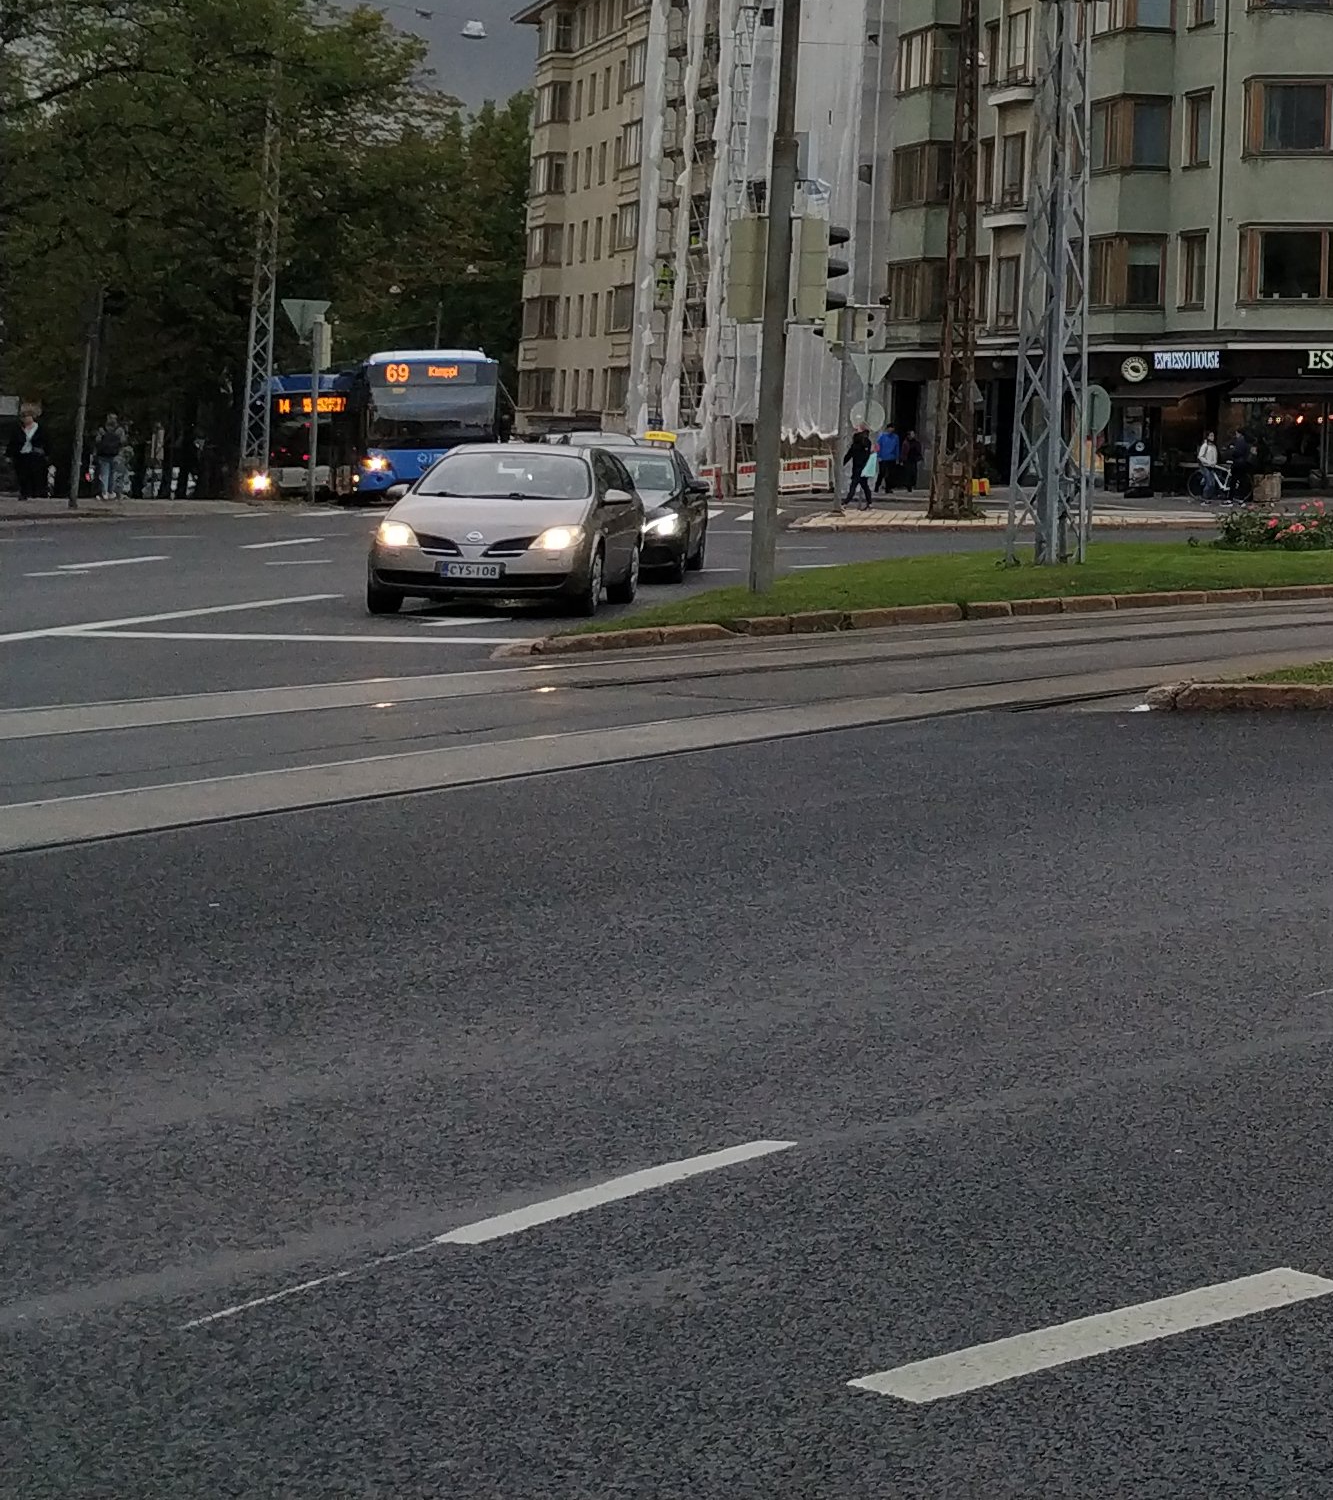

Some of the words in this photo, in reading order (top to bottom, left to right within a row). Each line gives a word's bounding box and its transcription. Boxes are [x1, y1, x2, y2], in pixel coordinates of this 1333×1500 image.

[1153, 350, 1191, 370] ESPRESSO
[1191, 350, 1220, 369] HOUSE
[386, 363, 410, 383] 69
[450, 564, 497, 577] CYS-108
